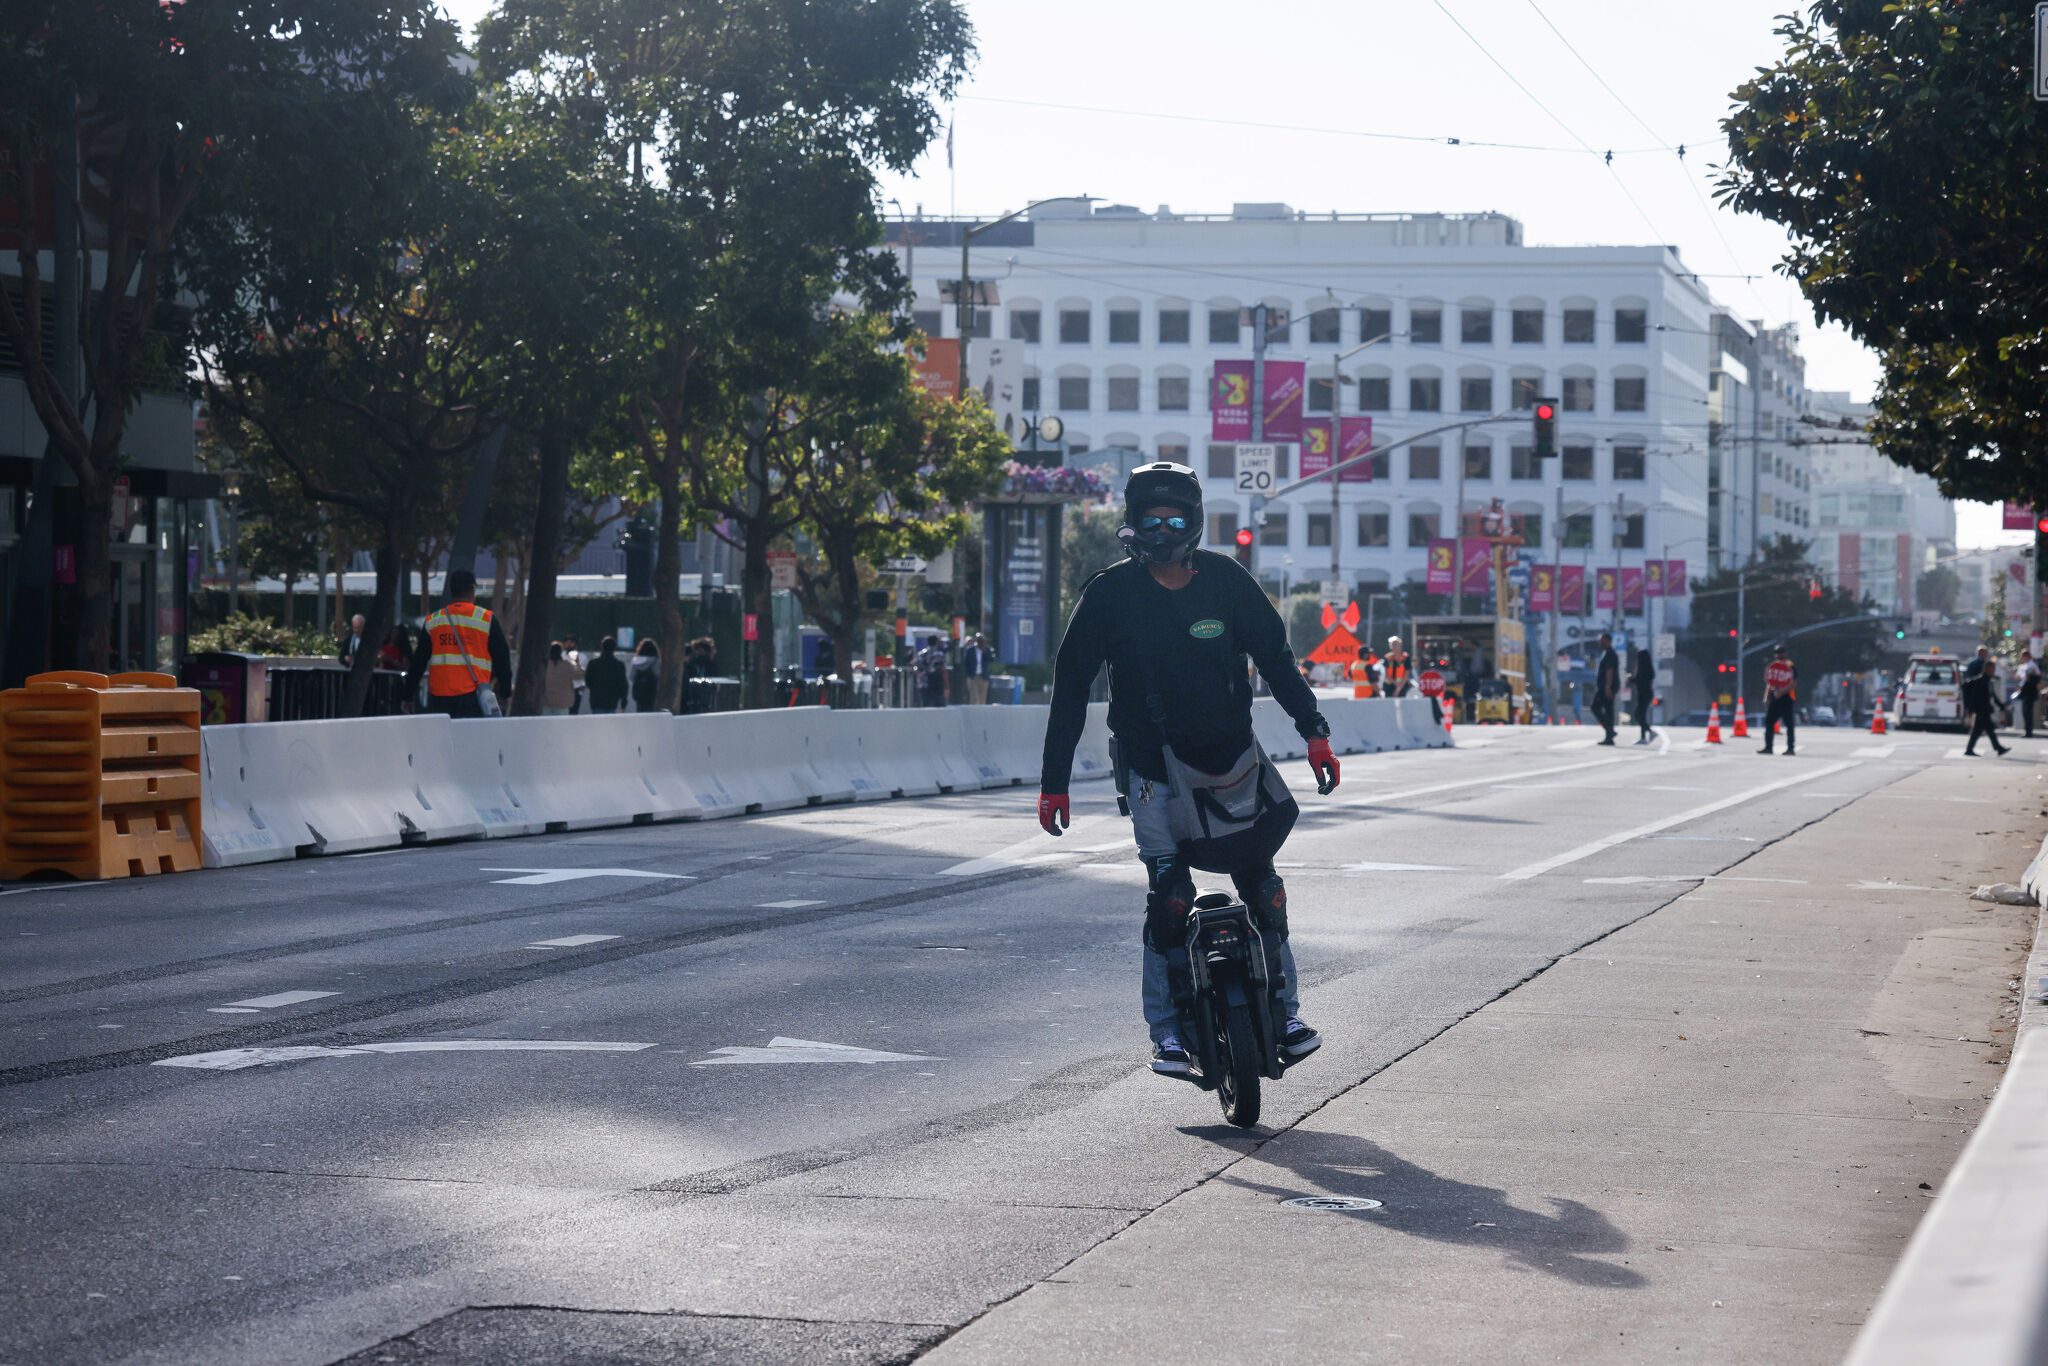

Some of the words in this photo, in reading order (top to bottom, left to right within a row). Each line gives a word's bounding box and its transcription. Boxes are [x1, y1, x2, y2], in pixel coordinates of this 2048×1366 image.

[1239, 448, 1272, 456] SPEED
[1242, 459, 1268, 467] LIMIT
[1239, 471, 1271, 489] 20
[1325, 645, 1357, 655] LANE
[1766, 669, 1792, 682] STOP
[1419, 678, 1445, 690] STOP
